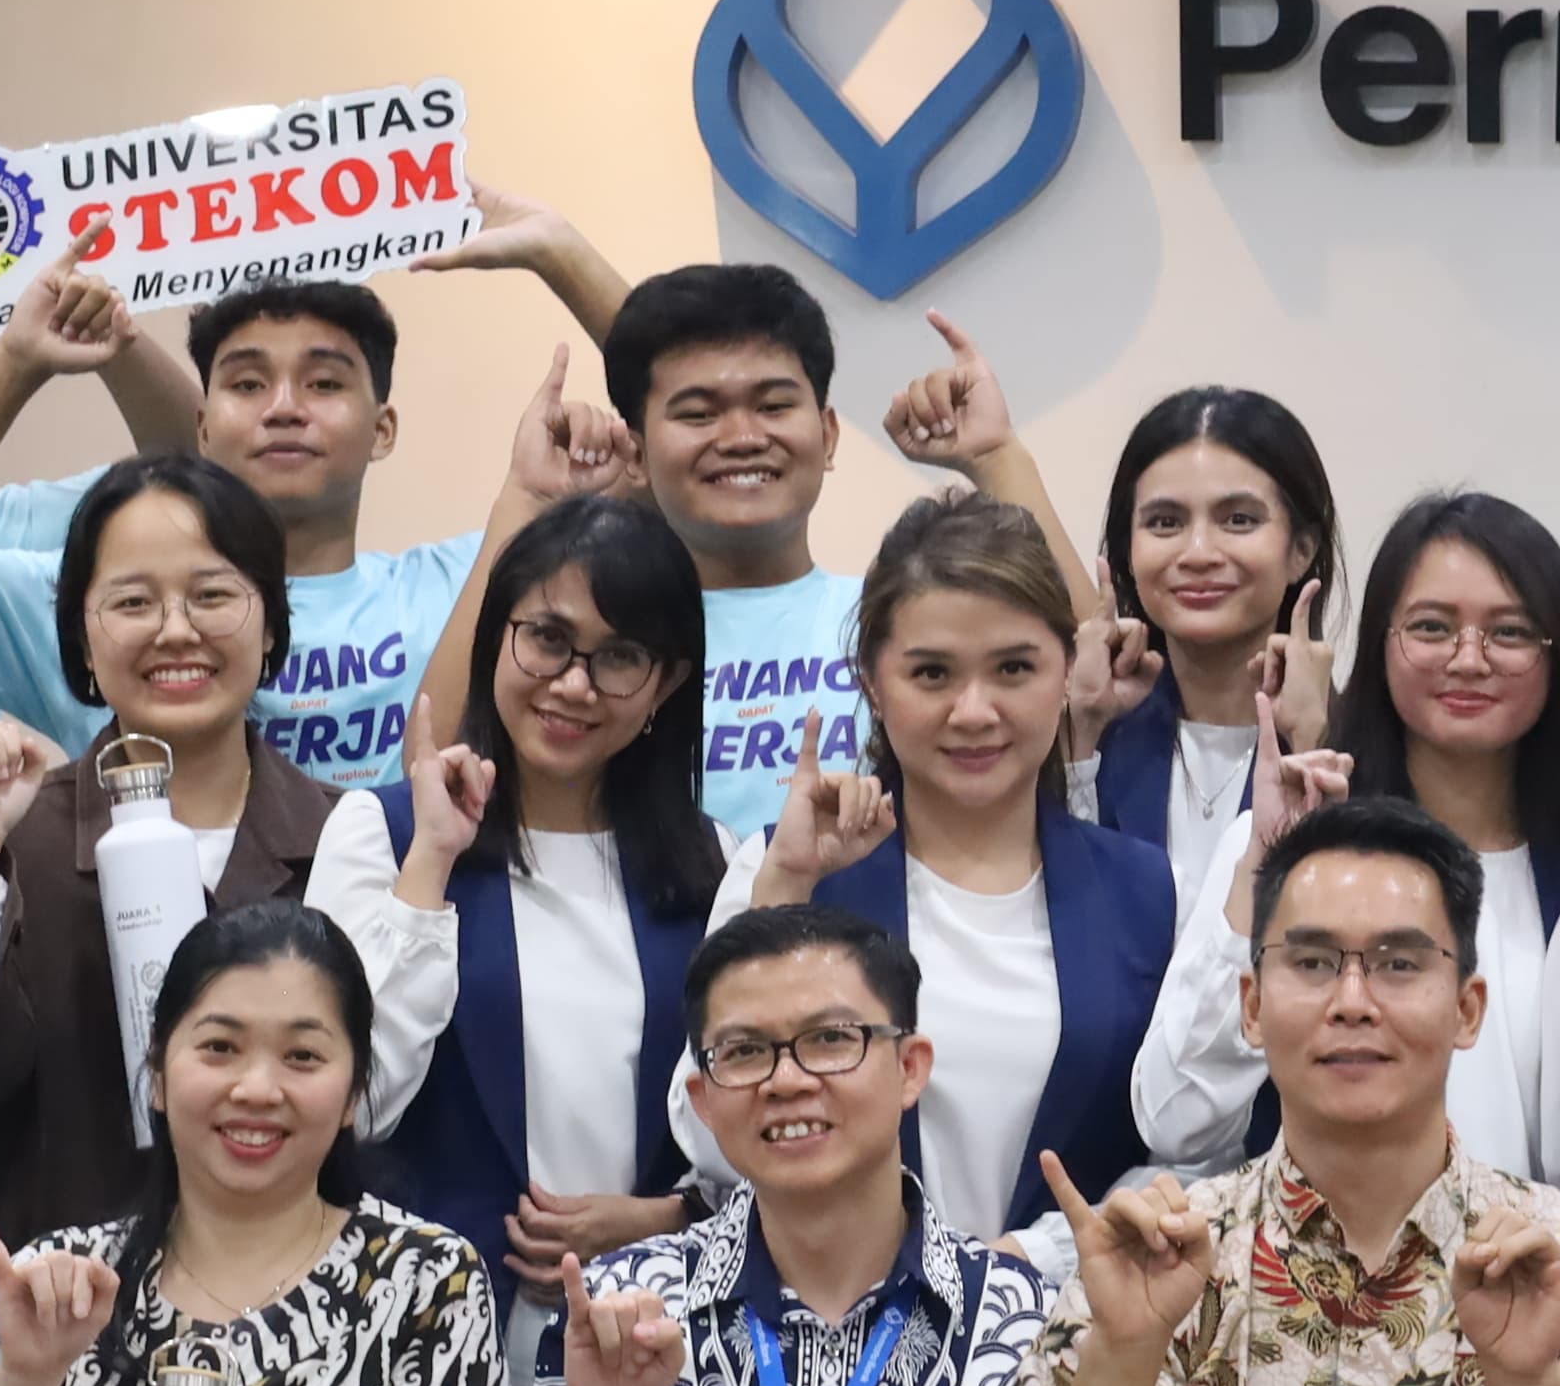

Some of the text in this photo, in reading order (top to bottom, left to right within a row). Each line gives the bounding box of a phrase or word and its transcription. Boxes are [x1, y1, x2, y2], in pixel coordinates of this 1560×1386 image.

[61, 89, 456, 191] UNIVERSITAS
[67, 141, 459, 263] STEKOM
[132, 228, 445, 301] Menyenangkan
[263, 631, 406, 695] NANG
[264, 702, 407, 766] ERJA
[704, 714, 858, 773] ERJA
